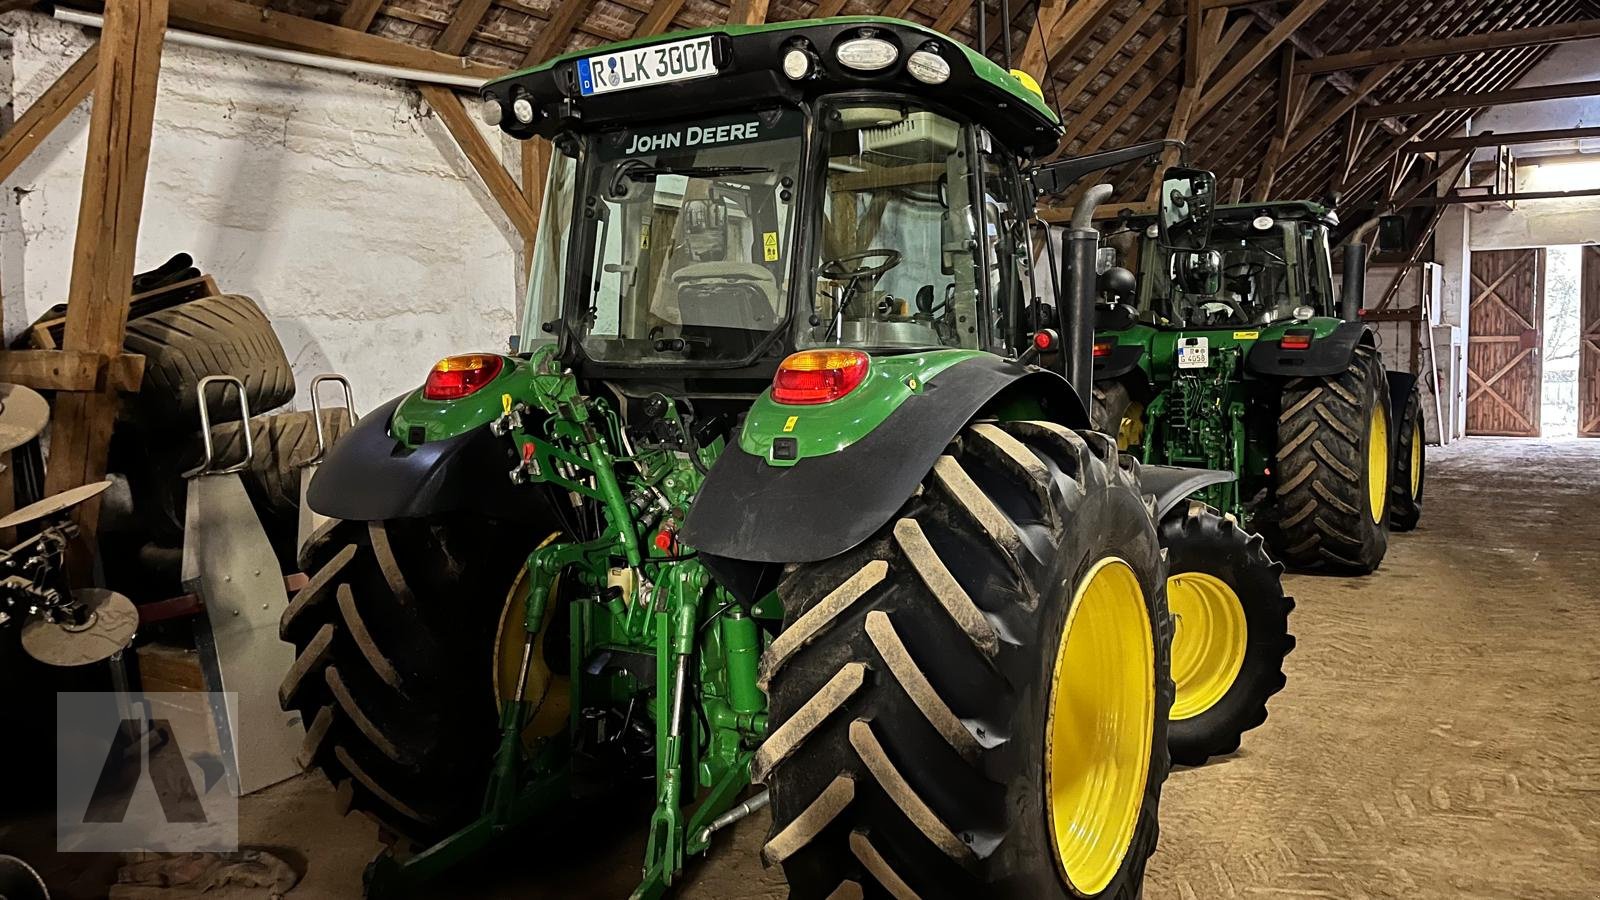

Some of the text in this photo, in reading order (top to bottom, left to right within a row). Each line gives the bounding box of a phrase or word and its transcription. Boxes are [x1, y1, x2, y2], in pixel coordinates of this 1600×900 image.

[592, 40, 711, 88] R LK 3007
[584, 80, 590, 89] D
[625, 121, 760, 155] JOHN DEERE
